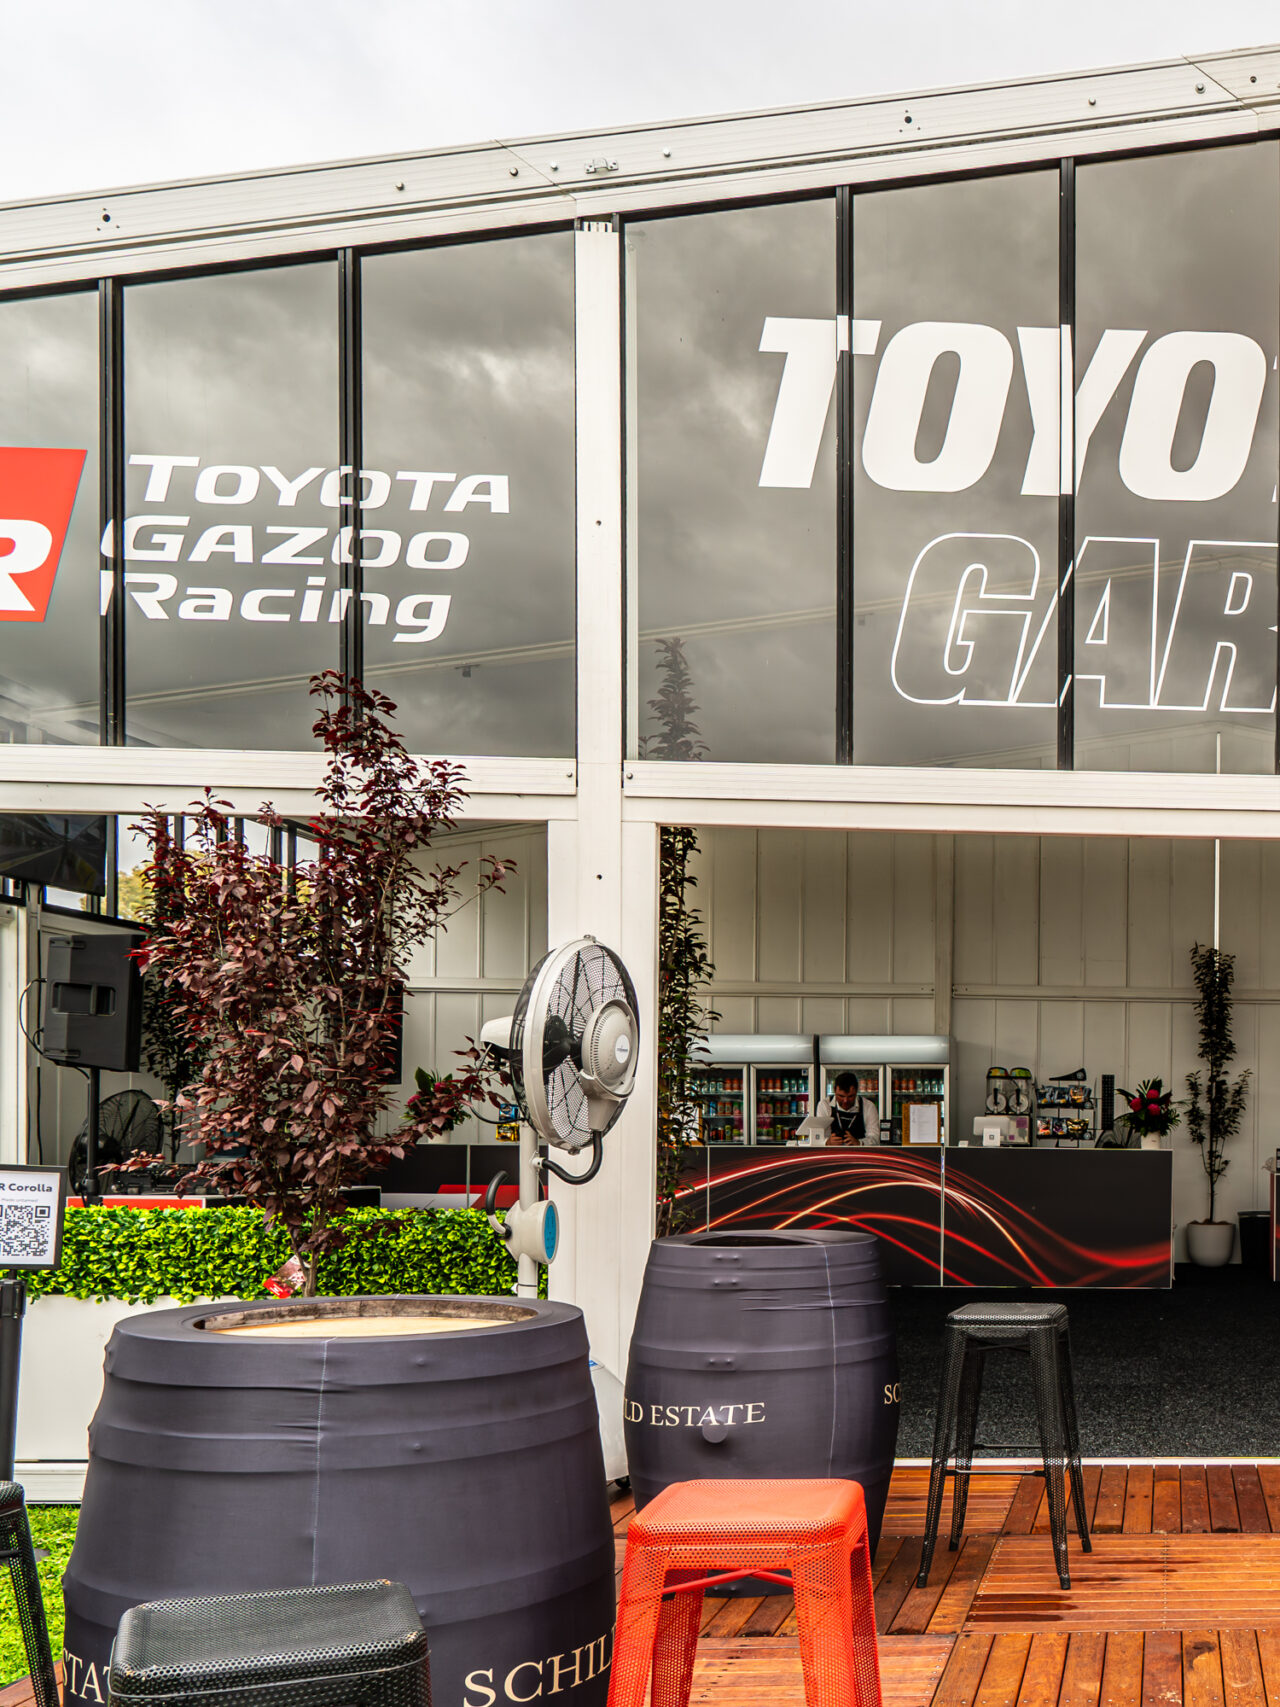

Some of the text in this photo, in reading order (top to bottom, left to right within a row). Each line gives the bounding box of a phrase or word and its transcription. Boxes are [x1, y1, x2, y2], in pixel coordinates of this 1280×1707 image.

[128, 454, 511, 514] TOYOTA
[101, 514, 471, 570] GAZOO
[100, 569, 452, 643] Racing
[8, 1182, 53, 1193] Corolla
[650, 1402, 767, 1427] ESTATE
[463, 1622, 617, 1707] SCHIL
